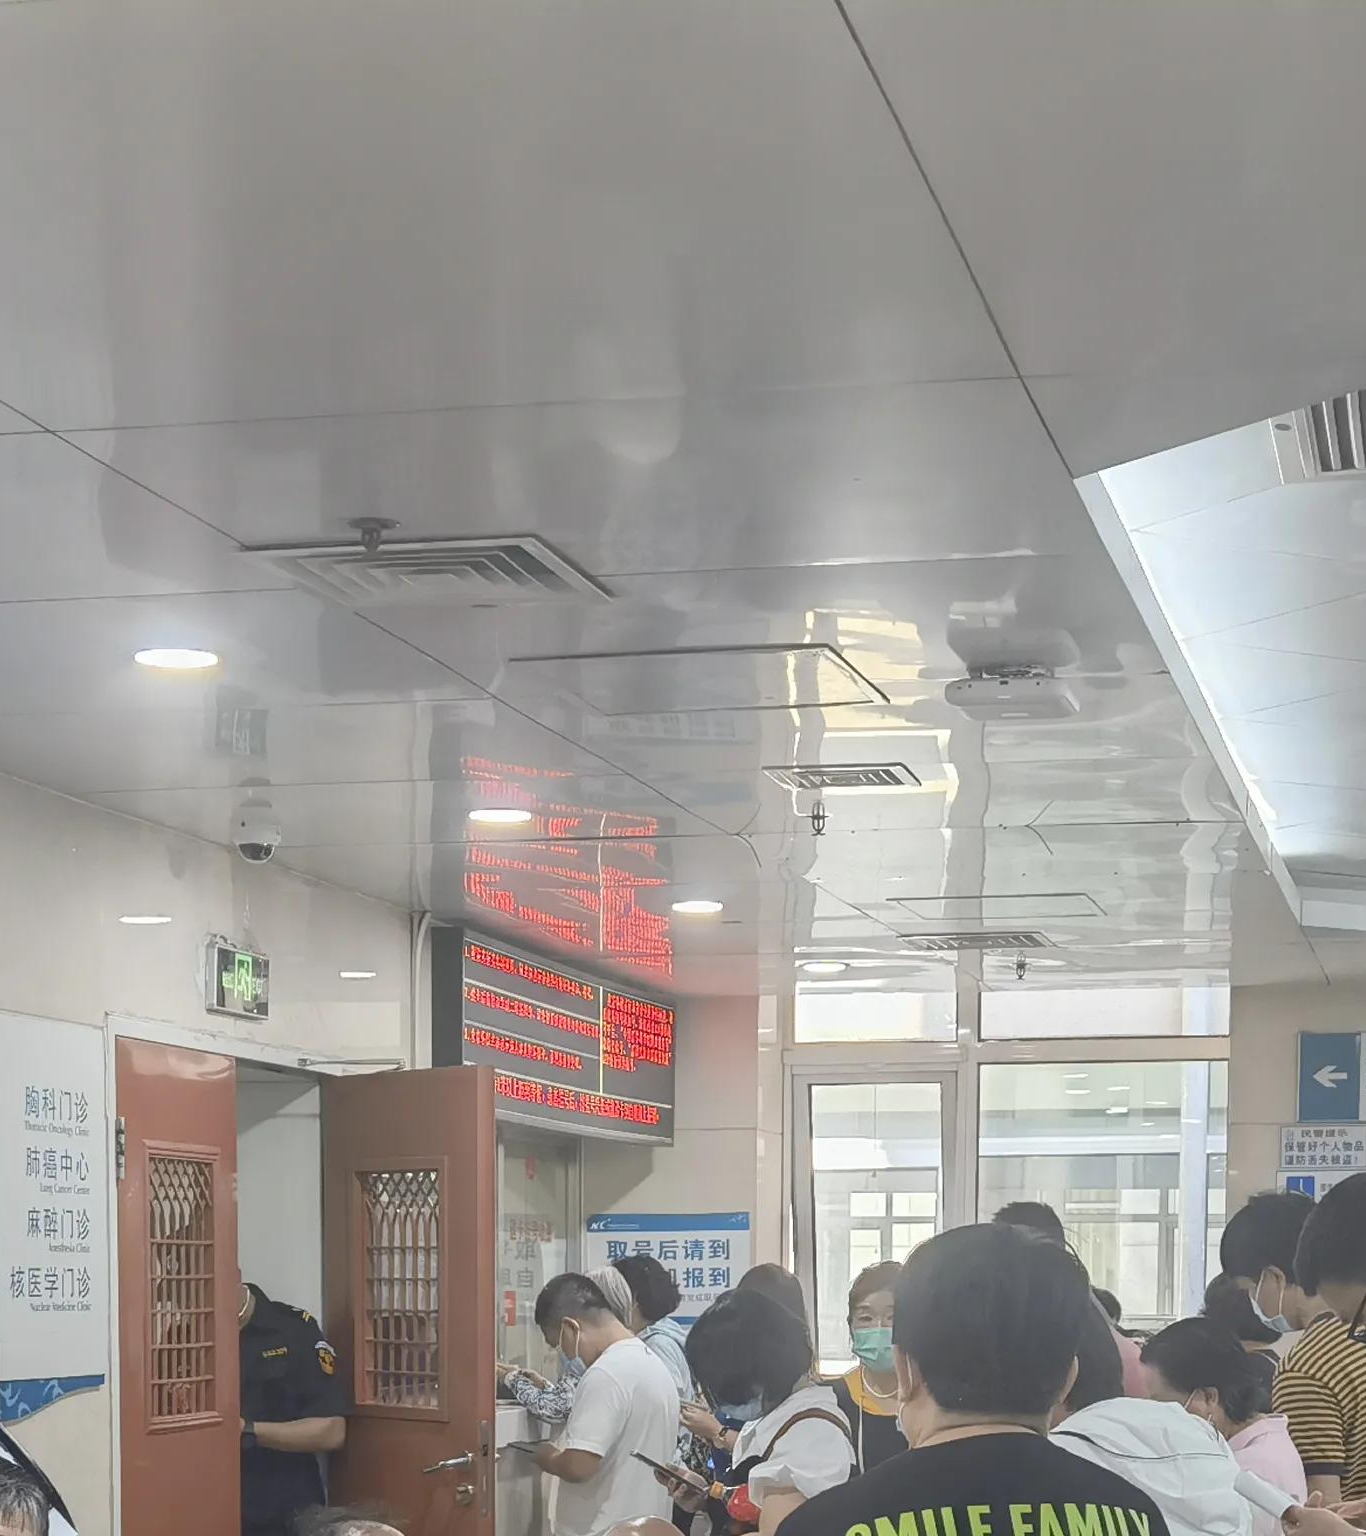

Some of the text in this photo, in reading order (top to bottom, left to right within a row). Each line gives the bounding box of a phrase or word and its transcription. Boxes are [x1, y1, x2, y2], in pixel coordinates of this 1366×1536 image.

[24, 1085, 89, 1124] 胸科门诊
[26, 1146, 89, 1181] 肺癌中心
[27, 1207, 90, 1241] 麻醉门诊
[606, 1238, 731, 1261] 取号后请到
[10, 1266, 91, 1299] 核医学门诊
